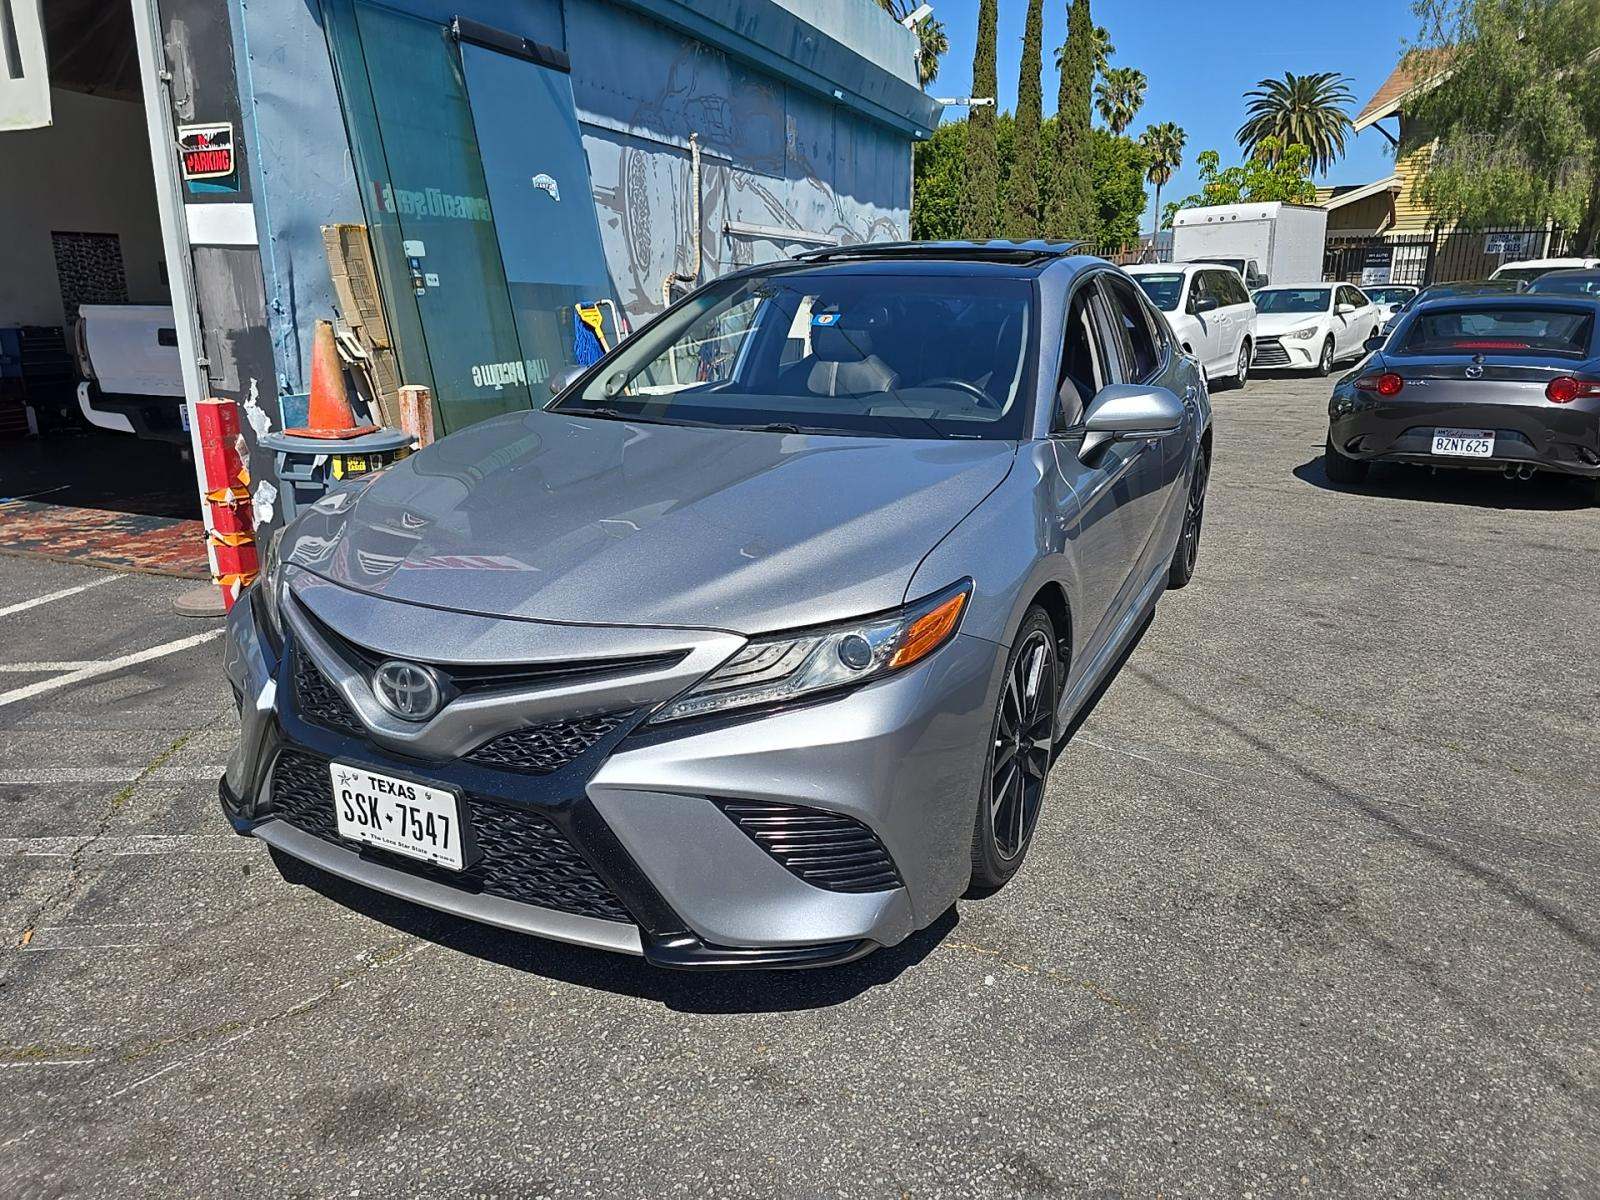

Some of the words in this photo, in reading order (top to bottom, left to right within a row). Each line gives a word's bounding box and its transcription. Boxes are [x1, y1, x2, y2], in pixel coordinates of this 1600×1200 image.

[187, 150, 229, 172] PARKING
[1487, 243, 1502, 252] AUTO
[1503, 243, 1521, 252] SALES
[1436, 438, 1489, 453] 8ZNT625
[368, 776, 416, 801] TEXAS
[370, 833, 382, 842] The
[382, 837, 397, 846] Lone
[398, 841, 410, 850] Star
[411, 845, 428, 855] State
